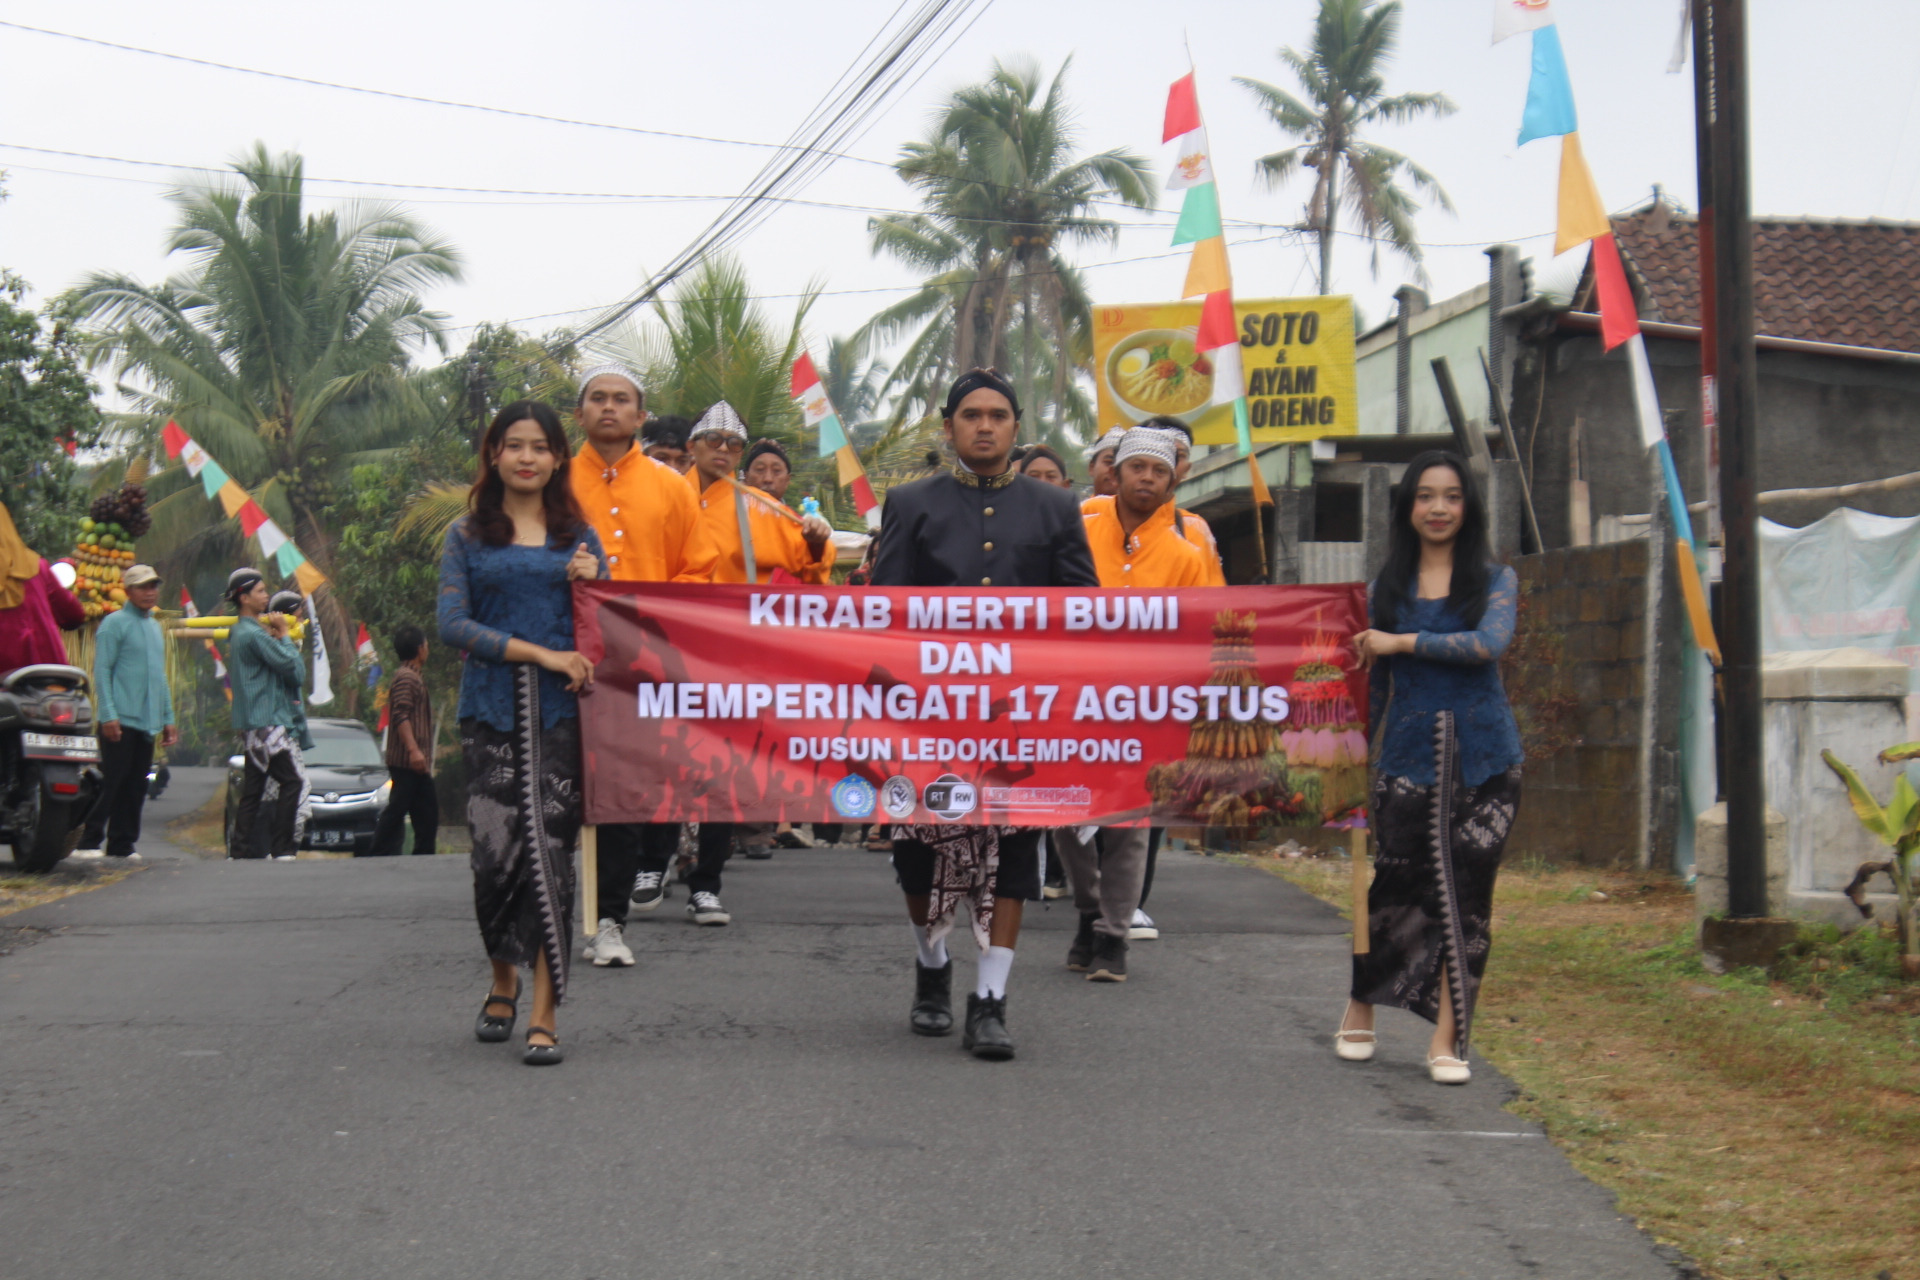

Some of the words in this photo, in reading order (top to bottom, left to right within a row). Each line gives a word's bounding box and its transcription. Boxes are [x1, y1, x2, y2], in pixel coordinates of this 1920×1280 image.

[1240, 310, 1320, 347] SOTO
[1275, 348, 1287, 364] &
[1248, 365, 1318, 396] AYAM
[1234, 396, 1336, 428] ORENG
[750, 593, 892, 629] KIRAB
[907, 596, 1048, 630] MERTI
[1065, 596, 1179, 630] BUMI
[920, 641, 1012, 675] DAN
[638, 682, 991, 721] MEMPERINGATI
[1009, 685, 1060, 721] 17
[1072, 684, 1290, 722] AGUSTUS
[788, 737, 892, 762] DUSUN
[902, 738, 1143, 763] LEDOKLEMPONG
[930, 791, 945, 802] RT
[955, 792, 973, 802] RW
